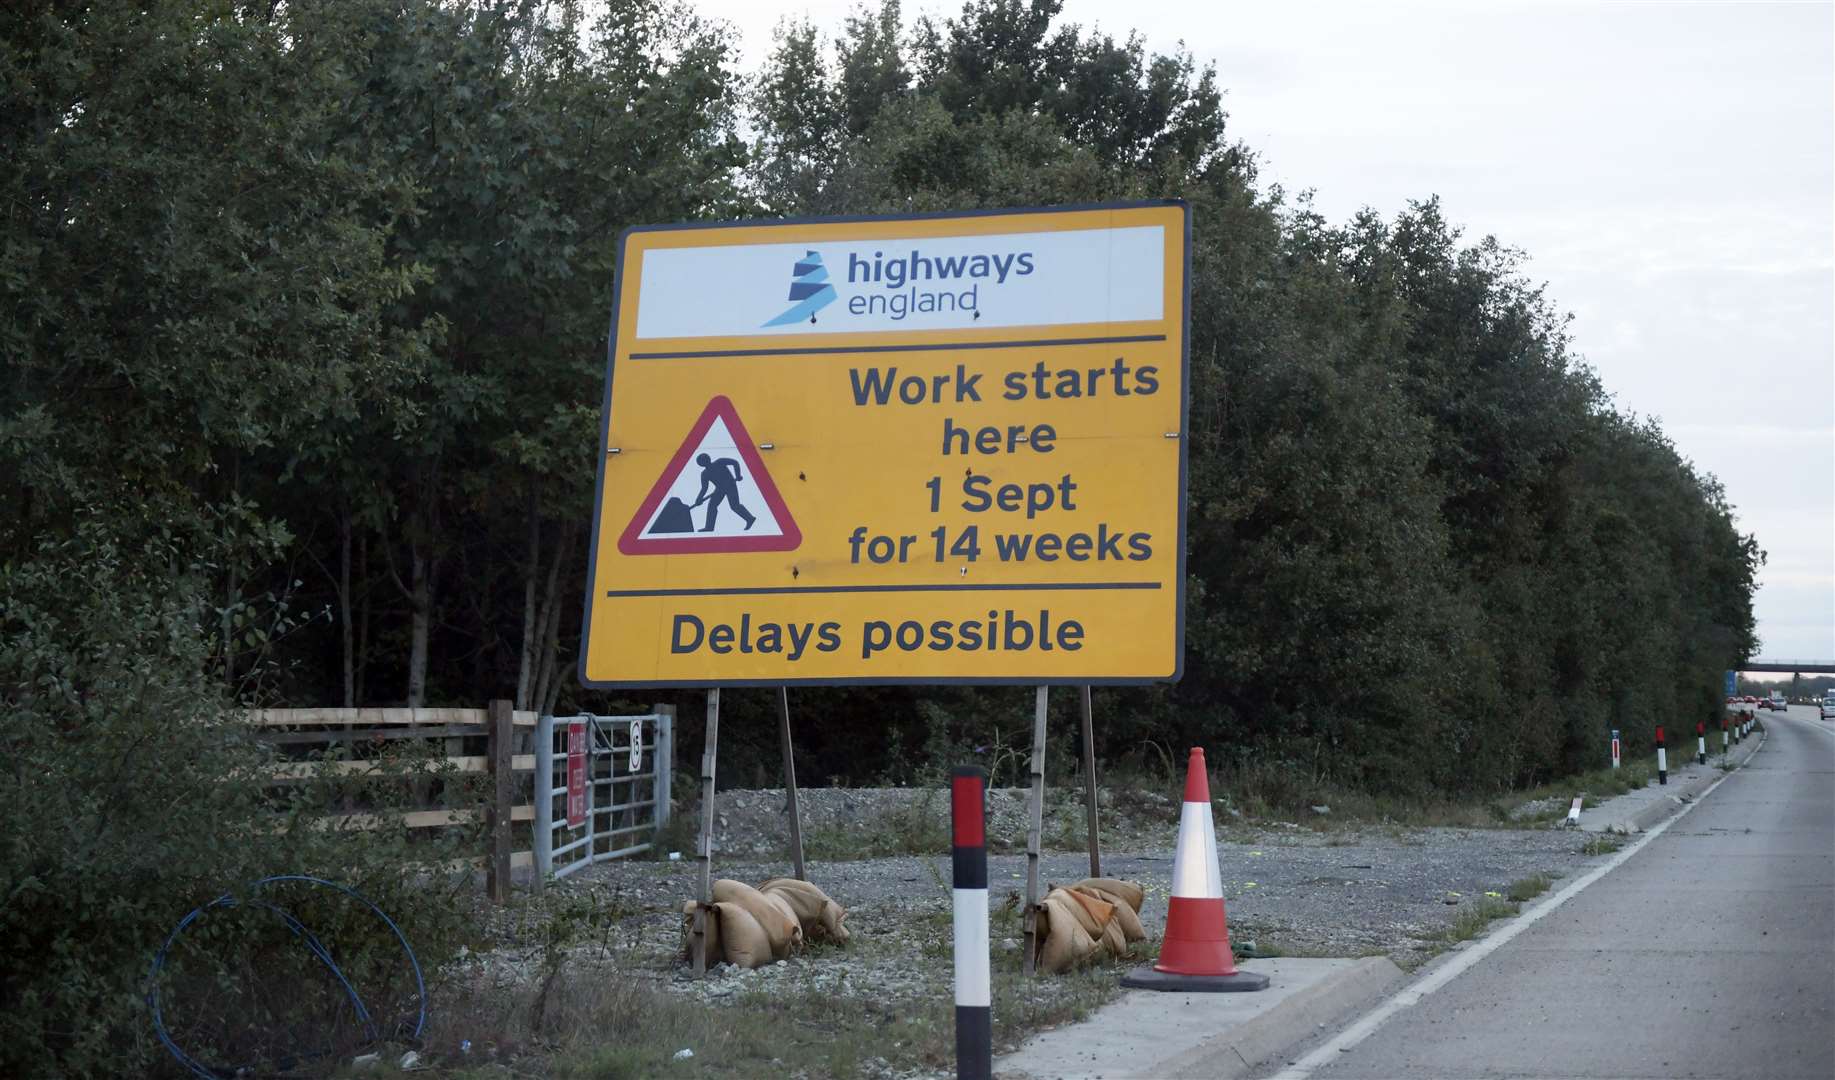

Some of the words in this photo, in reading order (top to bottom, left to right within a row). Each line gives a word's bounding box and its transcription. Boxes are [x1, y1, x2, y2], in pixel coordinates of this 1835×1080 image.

[847, 250, 1035, 289] highways
[848, 283, 977, 320] england
[849, 365, 982, 406] Work
[1003, 358, 1160, 401] starts
[942, 417, 1056, 456] here
[926, 476, 940, 513] 1
[962, 472, 1078, 520] Sept
[848, 526, 917, 564] for
[930, 525, 981, 563] 14
[994, 523, 1153, 562] weeks
[670, 613, 842, 662] Delays
[862, 609, 1085, 660] possible
